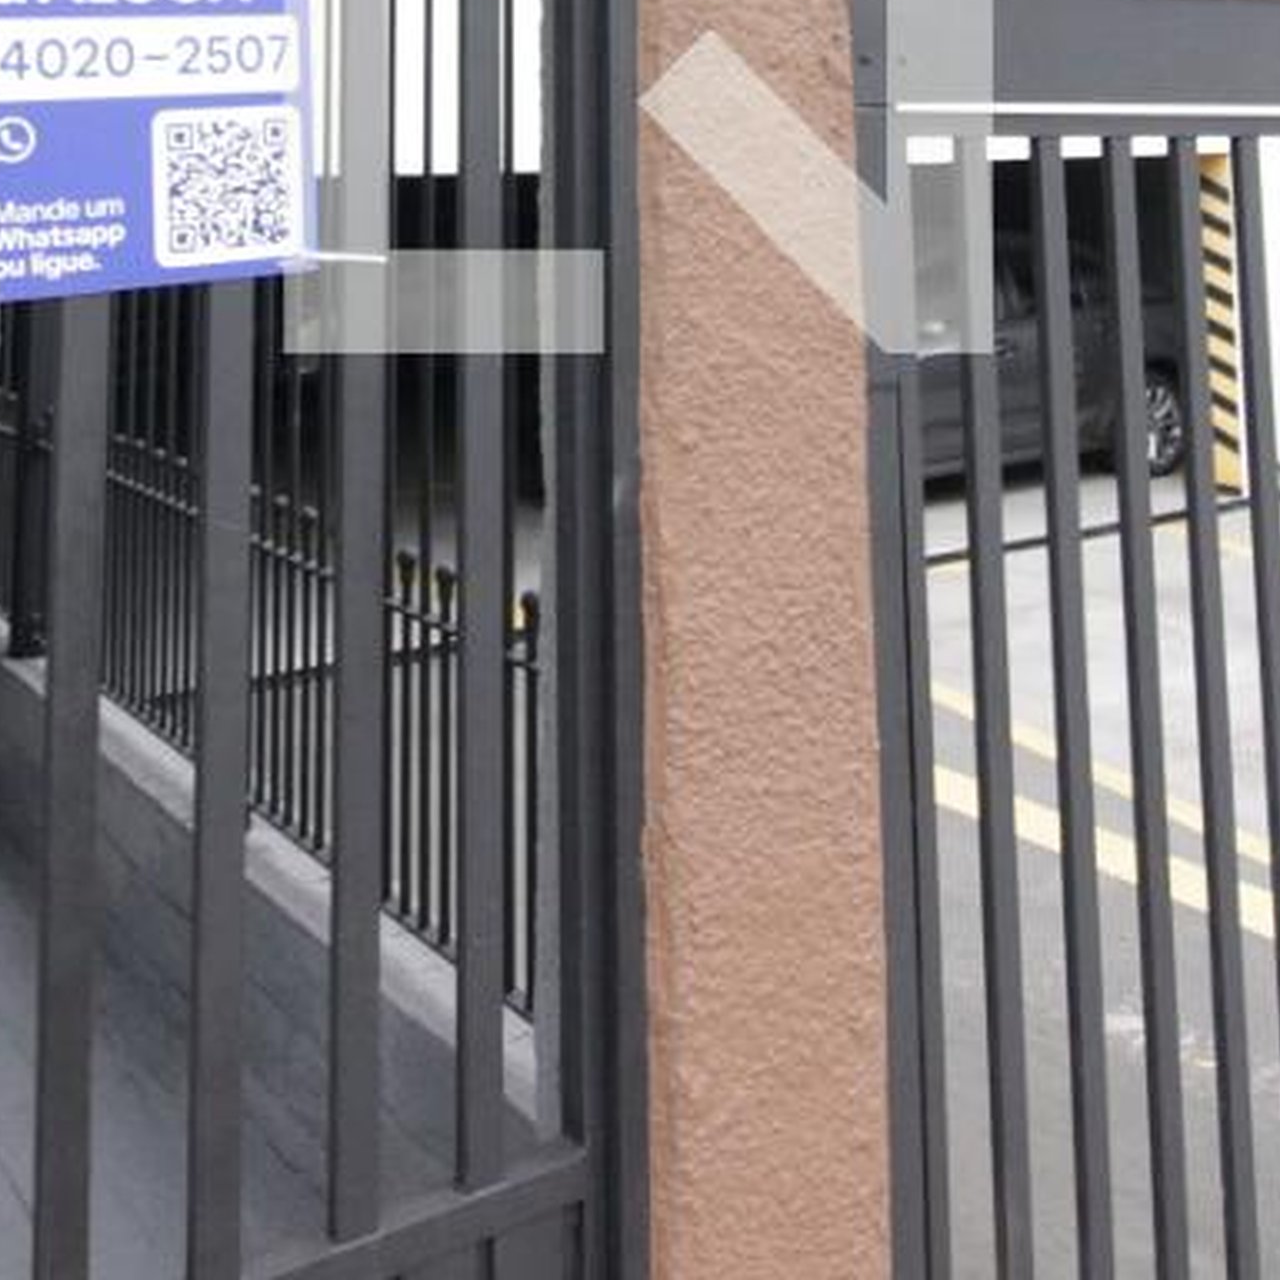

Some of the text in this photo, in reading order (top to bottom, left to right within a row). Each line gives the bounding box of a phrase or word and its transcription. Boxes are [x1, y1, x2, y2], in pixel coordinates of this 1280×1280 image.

[0, 35, 291, 80] 4020-2507
[84, 197, 126, 218] um
[30, 250, 103, 281] ligue.
